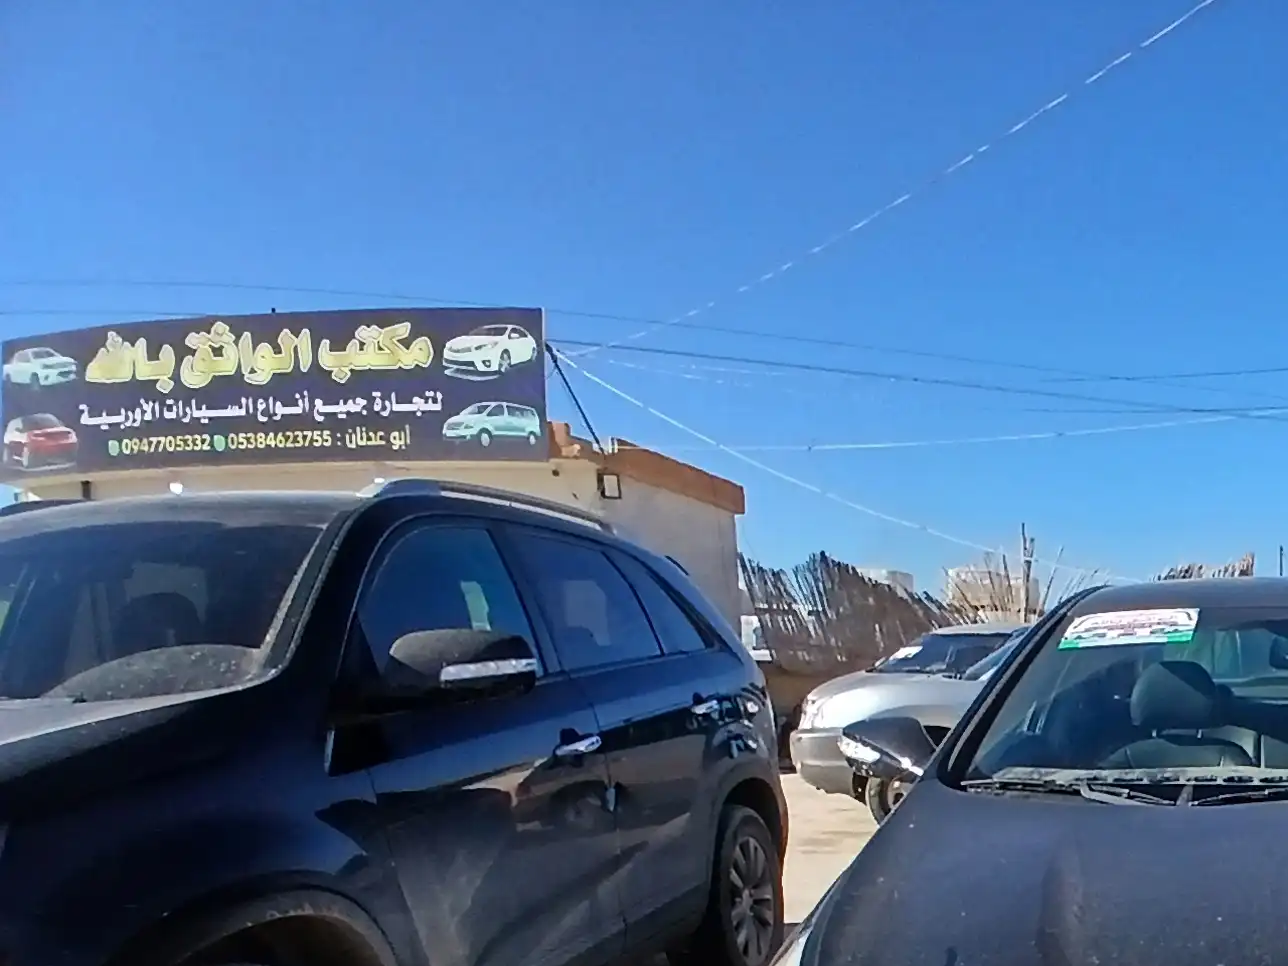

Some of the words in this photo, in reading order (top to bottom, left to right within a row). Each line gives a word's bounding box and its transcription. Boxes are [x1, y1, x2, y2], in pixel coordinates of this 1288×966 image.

[85, 331, 176, 394] بالله
[180, 321, 313, 389] الواثق
[318, 322, 434, 383] مكتب
[163, 396, 254, 424] السيارات
[314, 396, 368, 422] جميع
[372, 390, 443, 417] لتجارة
[121, 433, 211, 455] 0947705332
[228, 430, 332, 450] 05384623755
[345, 426, 386, 449] عدنان
